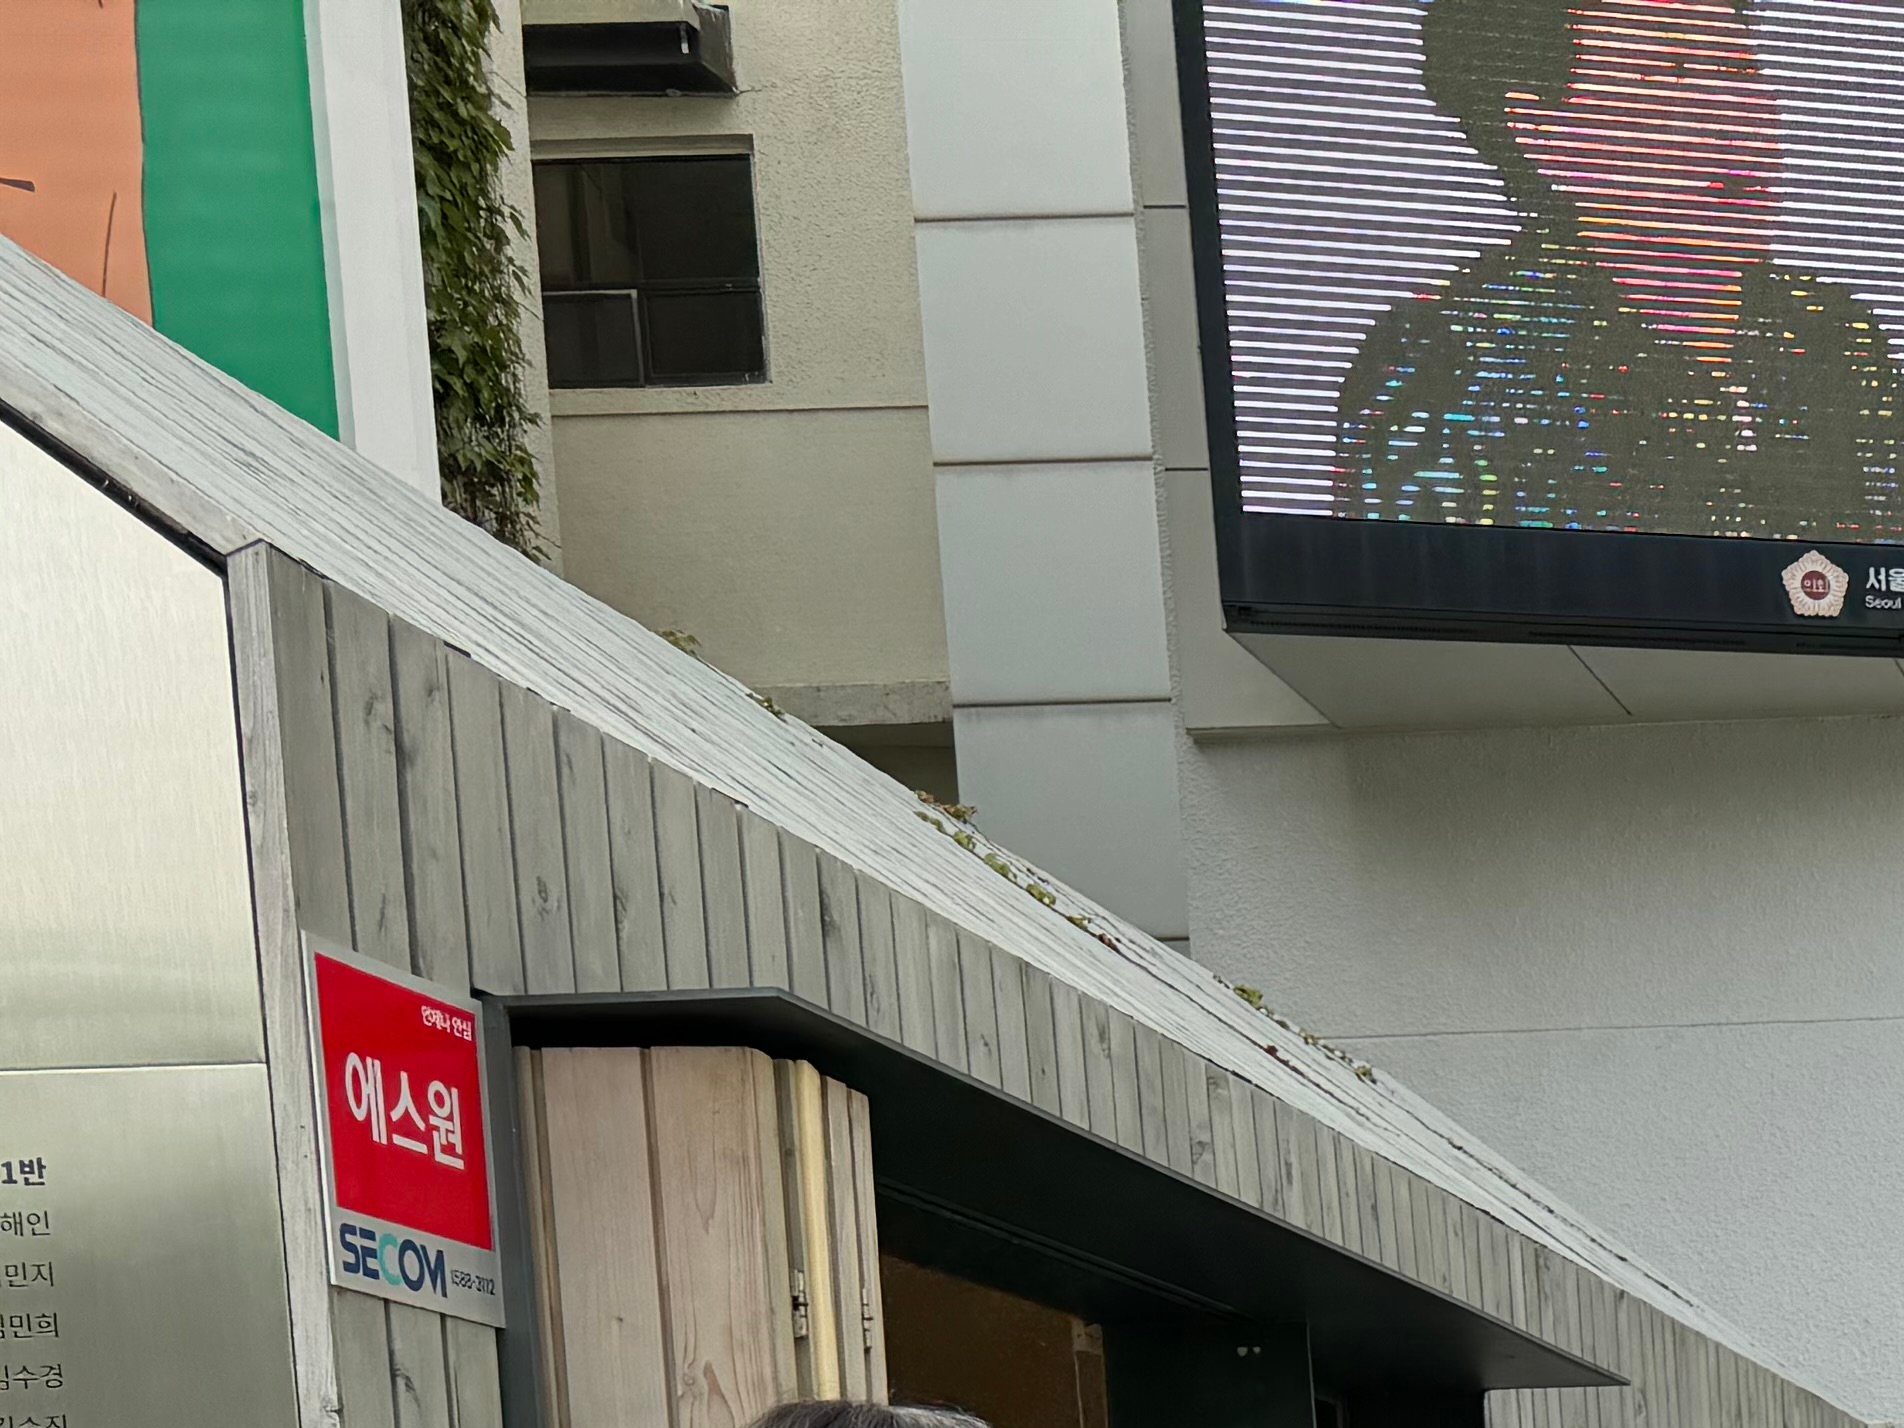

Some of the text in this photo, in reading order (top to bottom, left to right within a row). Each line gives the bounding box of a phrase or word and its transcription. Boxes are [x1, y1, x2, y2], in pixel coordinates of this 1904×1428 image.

[1865, 595, 1901, 610] Seoul
[344, 1051, 465, 1171] 에스원
[1, 1156, 47, 1186] 1반
[339, 1222, 448, 1299] SECOM
